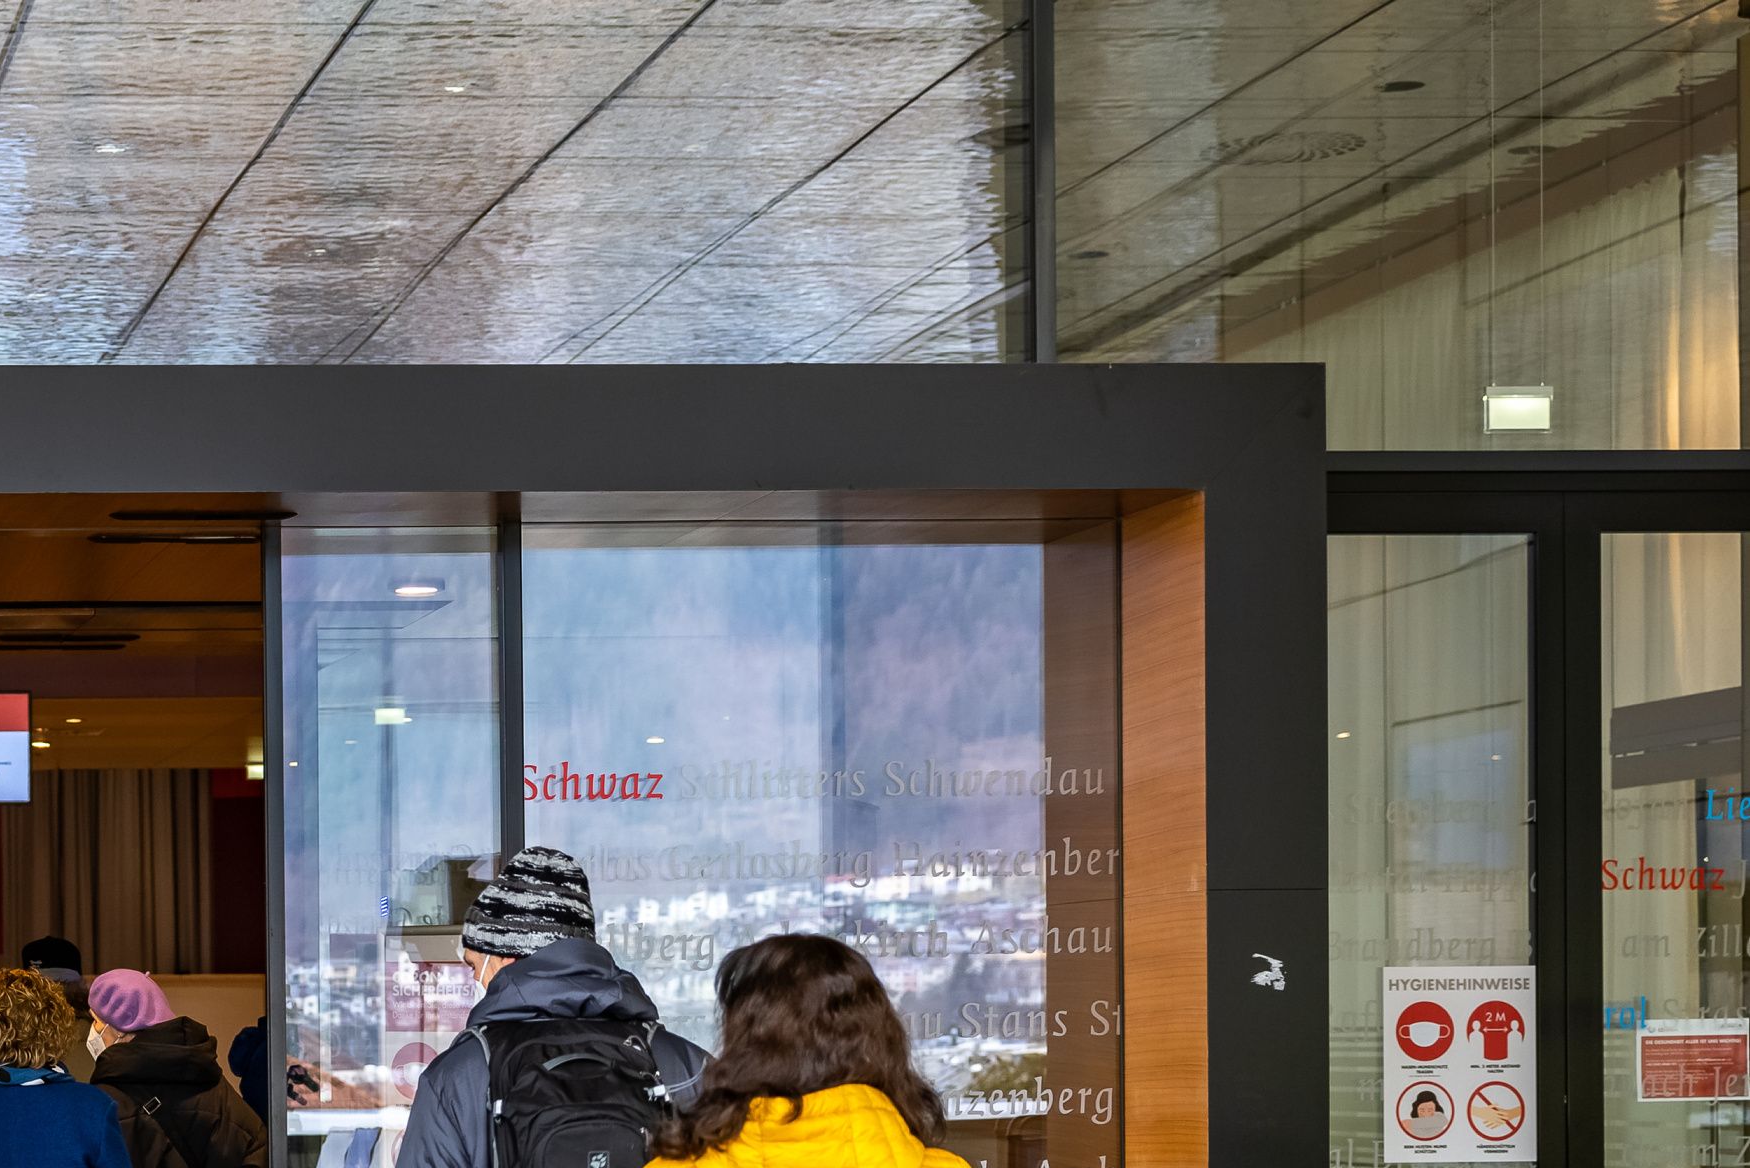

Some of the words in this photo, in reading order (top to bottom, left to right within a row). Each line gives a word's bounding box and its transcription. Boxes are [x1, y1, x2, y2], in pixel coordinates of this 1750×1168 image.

[523, 761, 664, 801] Schwaz
[883, 757, 1105, 798] Schwendau
[581, 845, 652, 882] rlos
[893, 837, 1120, 879] Hainzenber
[1601, 856, 1725, 891] Schwaz
[970, 915, 1114, 956] Aschau
[1697, 923, 1750, 958] Zill
[1388, 976, 1531, 993] HYGIENEHINWEISE
[961, 1001, 1069, 1039] Stans
[1485, 1012, 1494, 1022] 2
[1495, 1012, 1507, 1022] M
[942, 1076, 1114, 1125] nzenberg
